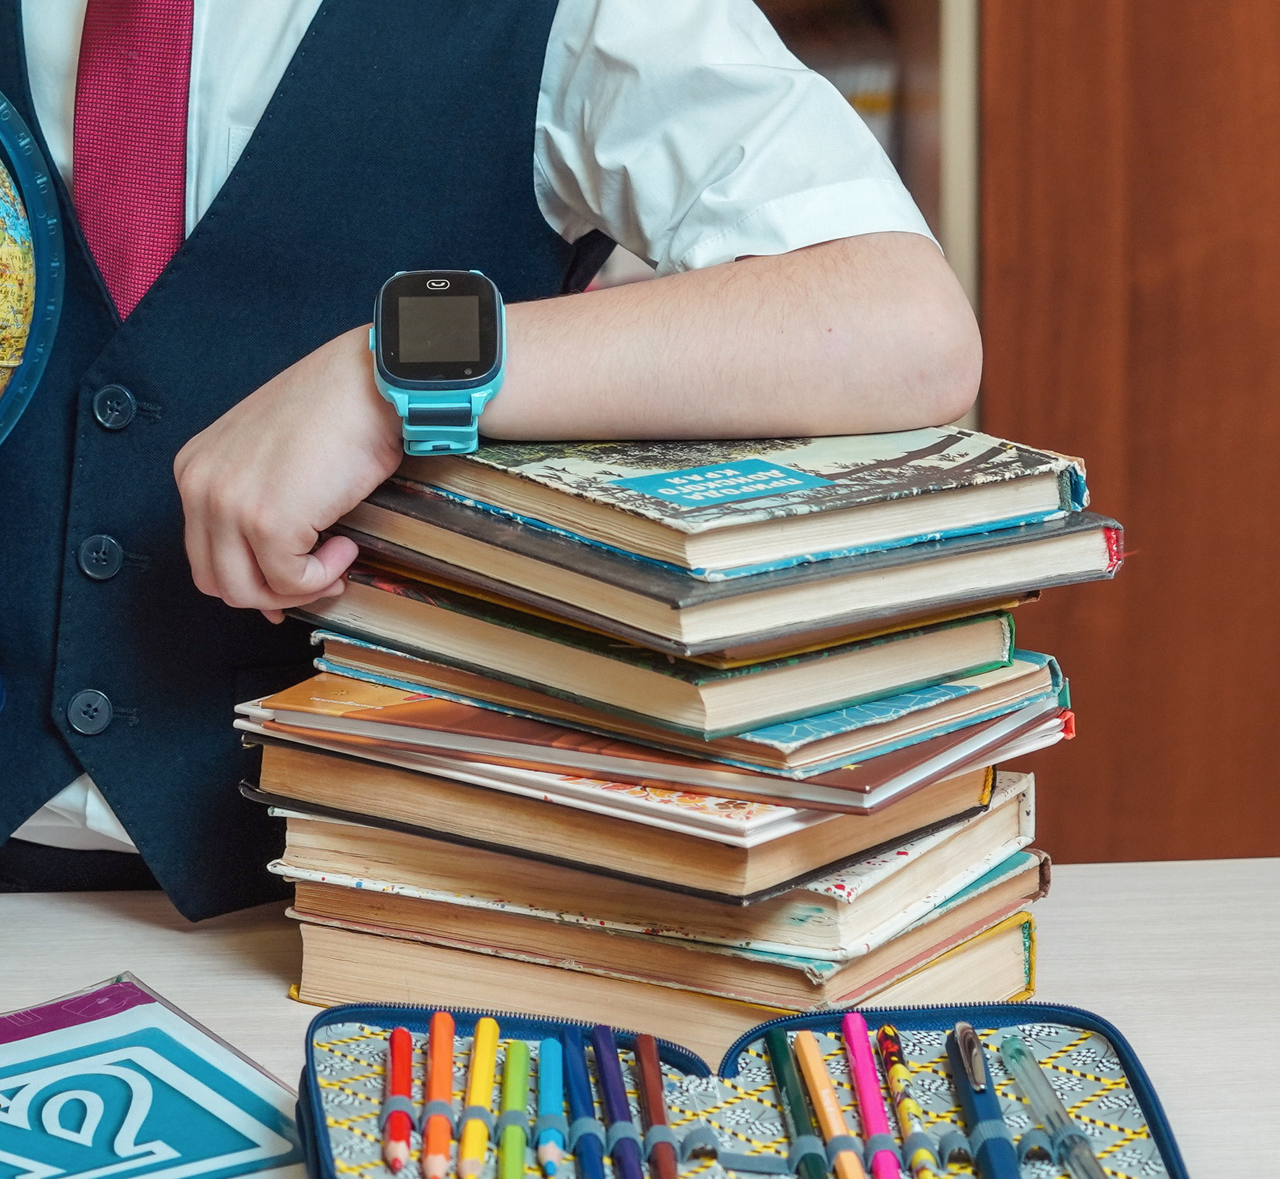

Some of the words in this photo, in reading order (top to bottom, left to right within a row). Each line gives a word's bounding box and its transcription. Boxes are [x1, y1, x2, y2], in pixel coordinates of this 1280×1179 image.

[657, 469, 787, 495] ДОНСКОГО
[665, 468, 741, 485] КРАЯ
[682, 477, 804, 501] ПРИРОДА
